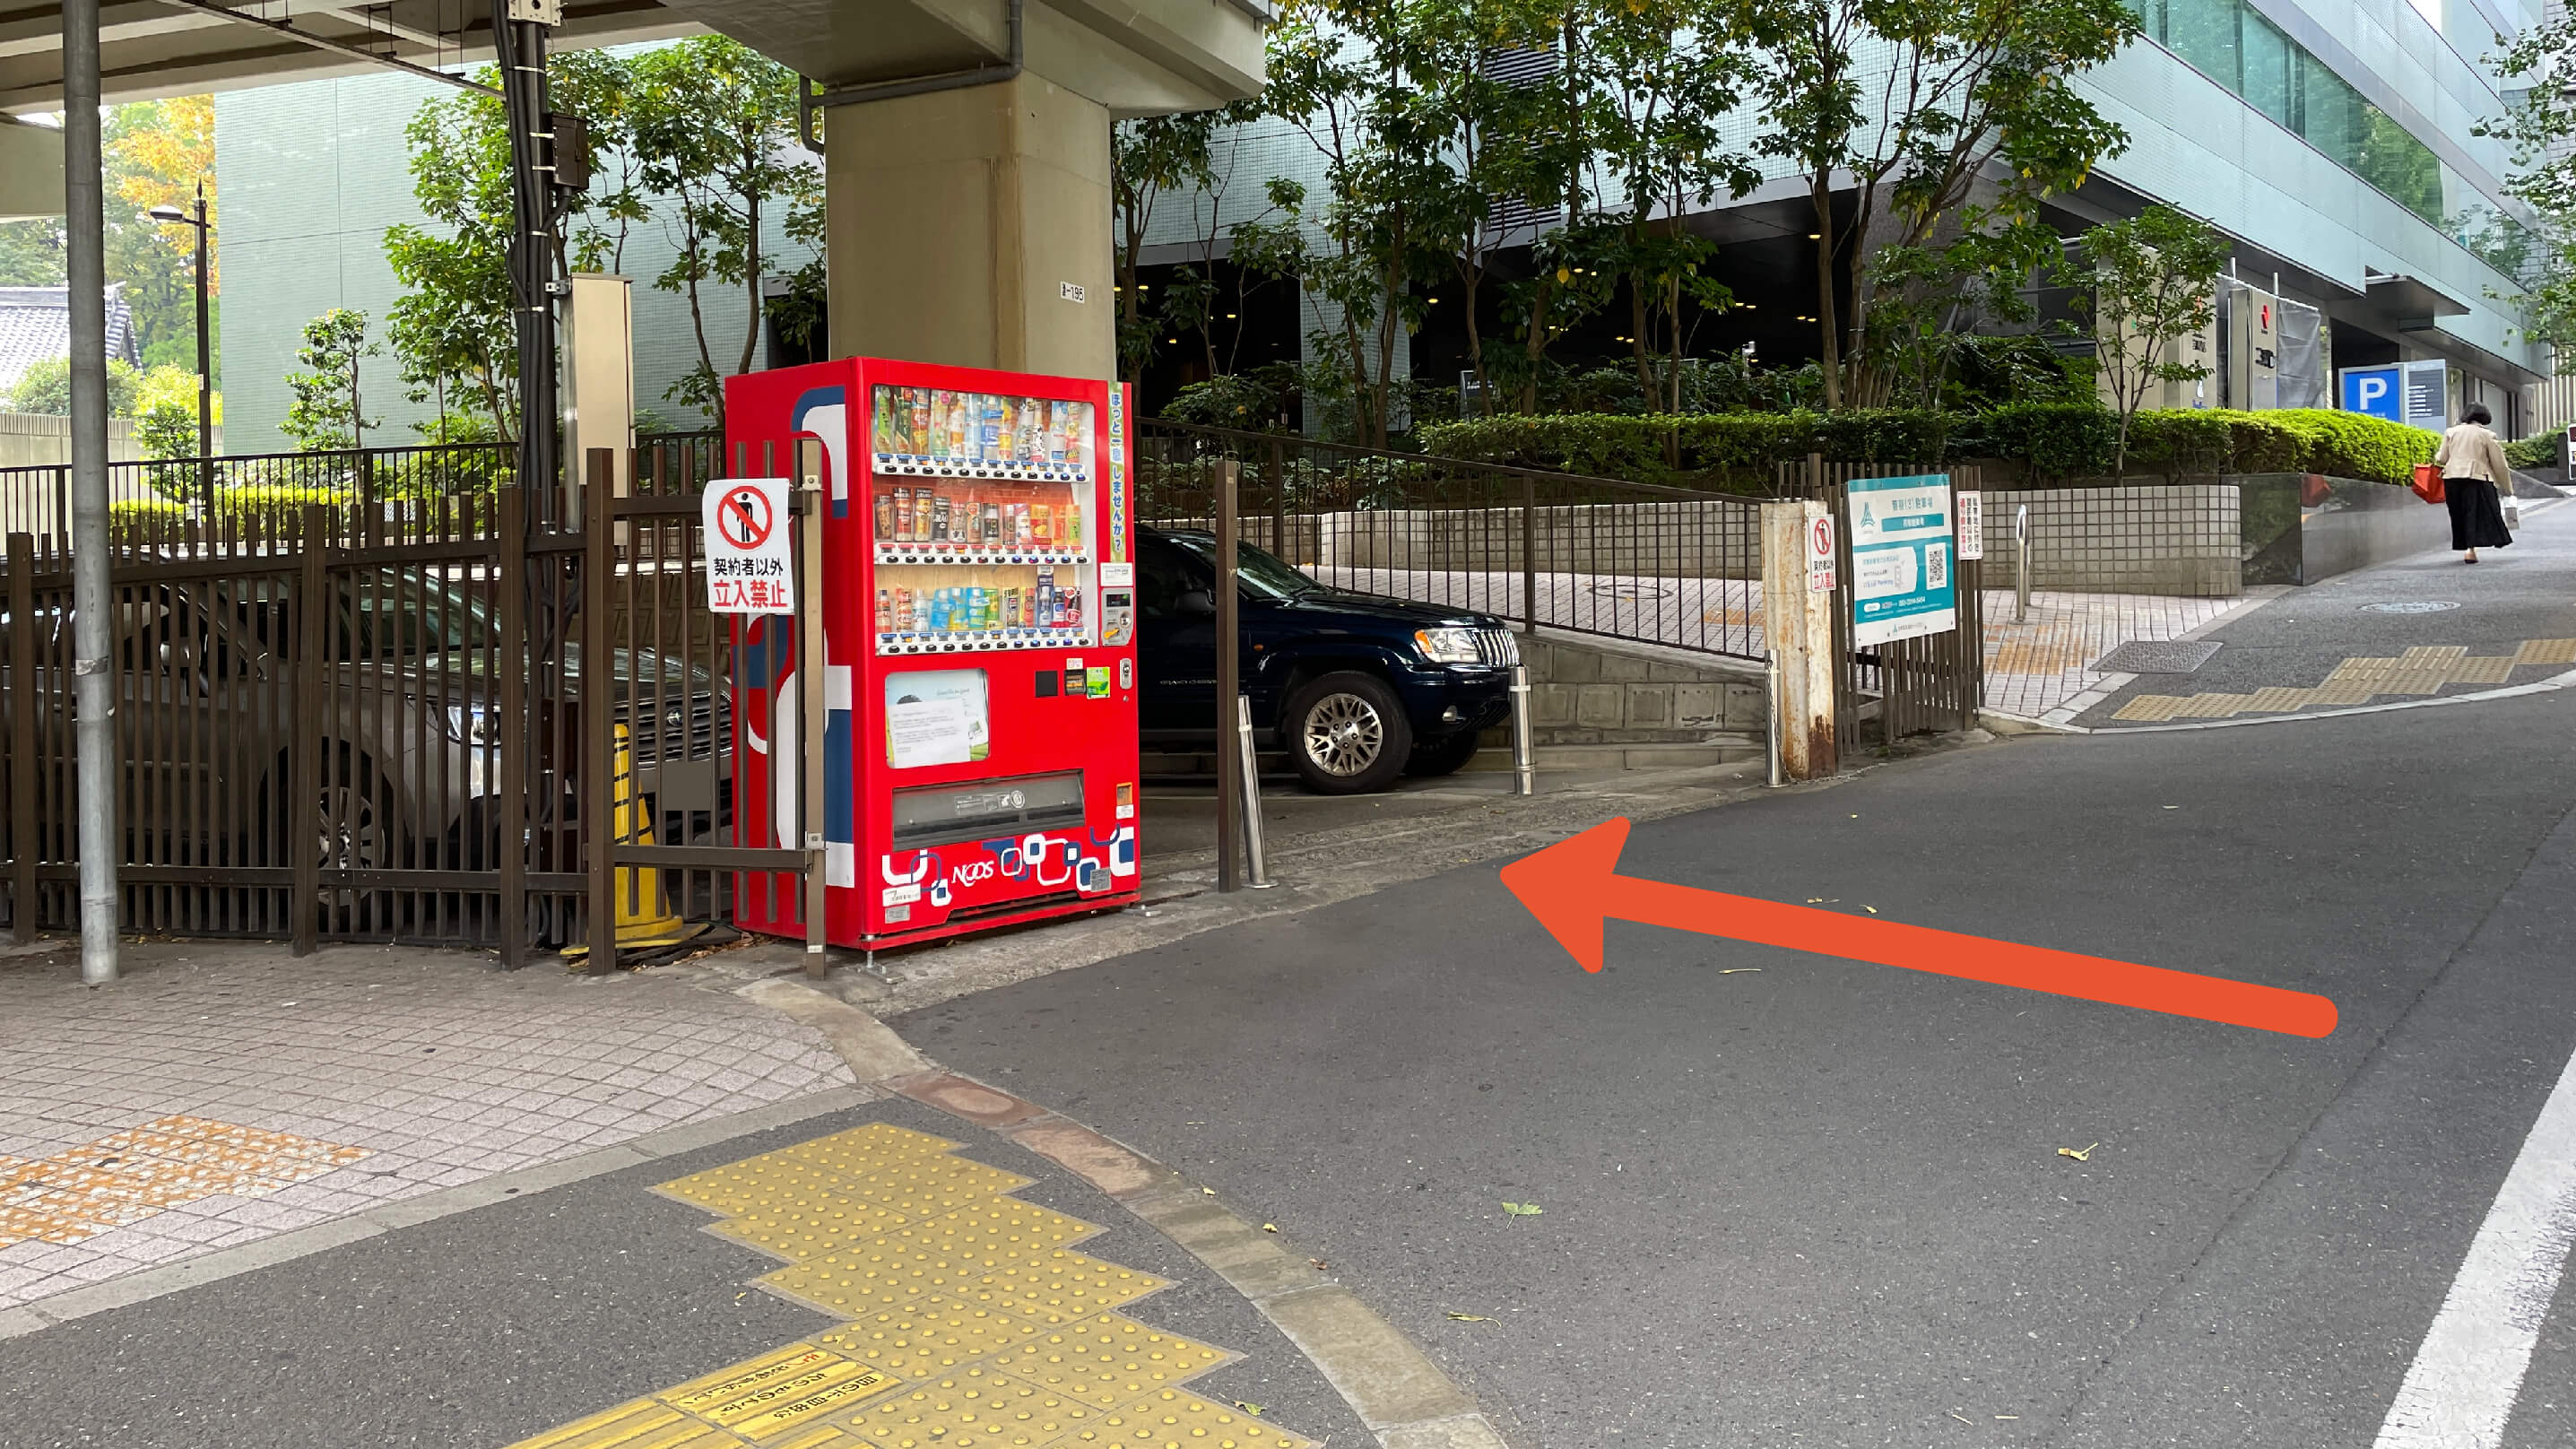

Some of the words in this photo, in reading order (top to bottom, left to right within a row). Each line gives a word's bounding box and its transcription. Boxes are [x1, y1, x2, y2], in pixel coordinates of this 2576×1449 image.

[2359, 377, 2387, 410] P
[714, 557, 784, 577] 契約者以外
[713, 579, 788, 608] 立入禁止
